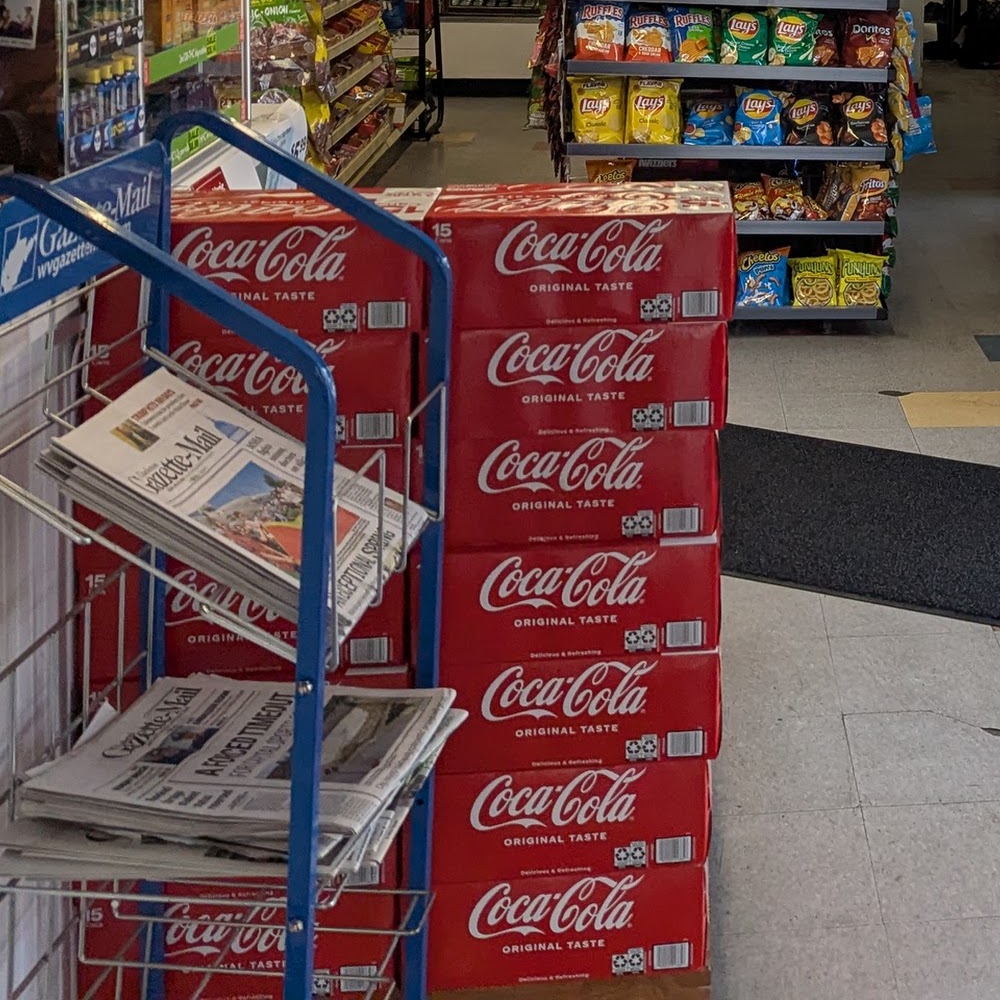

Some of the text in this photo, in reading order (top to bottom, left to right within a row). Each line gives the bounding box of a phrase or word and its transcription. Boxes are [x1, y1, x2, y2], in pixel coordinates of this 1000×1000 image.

[583, 5, 623, 19] RUFFLES
[630, 15, 669, 28] RUFFLES
[674, 14, 711, 26] RUFFLES
[730, 19, 757, 34] Lay's
[778, 21, 805, 37] Lay's
[853, 25, 890, 35] Doritos
[636, 96, 665, 111] Lay's
[860, 178, 886, 191] Fritos
[432, 223, 452, 238] 15
[494, 218, 673, 275] Coca-Cola
[171, 225, 356, 283] Coca-Cola
[742, 253, 780, 270] Cheetos
[795, 261, 834, 274] FUNYUNS
[843, 261, 880, 278] FUNYUNS
[530, 282, 633, 293] ORIGINAL TASTE
[275, 291, 315, 300] TASTE
[487, 328, 665, 387] Coca-Cola
[522, 391, 625, 403] ORIGINAL TASTE
[263, 404, 303, 413] TASTE
[478, 436, 653, 494] Coca-Cola
[513, 499, 615, 510] ORIGINAL TASTE
[480, 551, 657, 612] Coca-Cola
[514, 615, 617, 627] ORIGINAL TASTE
[481, 660, 658, 722] Coca-Cola
[515, 724, 619, 737] ORIGINAL TASTE
[470, 766, 647, 831] Coca-Cola
[504, 832, 607, 846] ORIGINAL TASTE
[468, 874, 644, 939] Coca-Cola
[86, 907, 103, 922] 15
[502, 940, 605, 954] ORIGINAL TASTE
